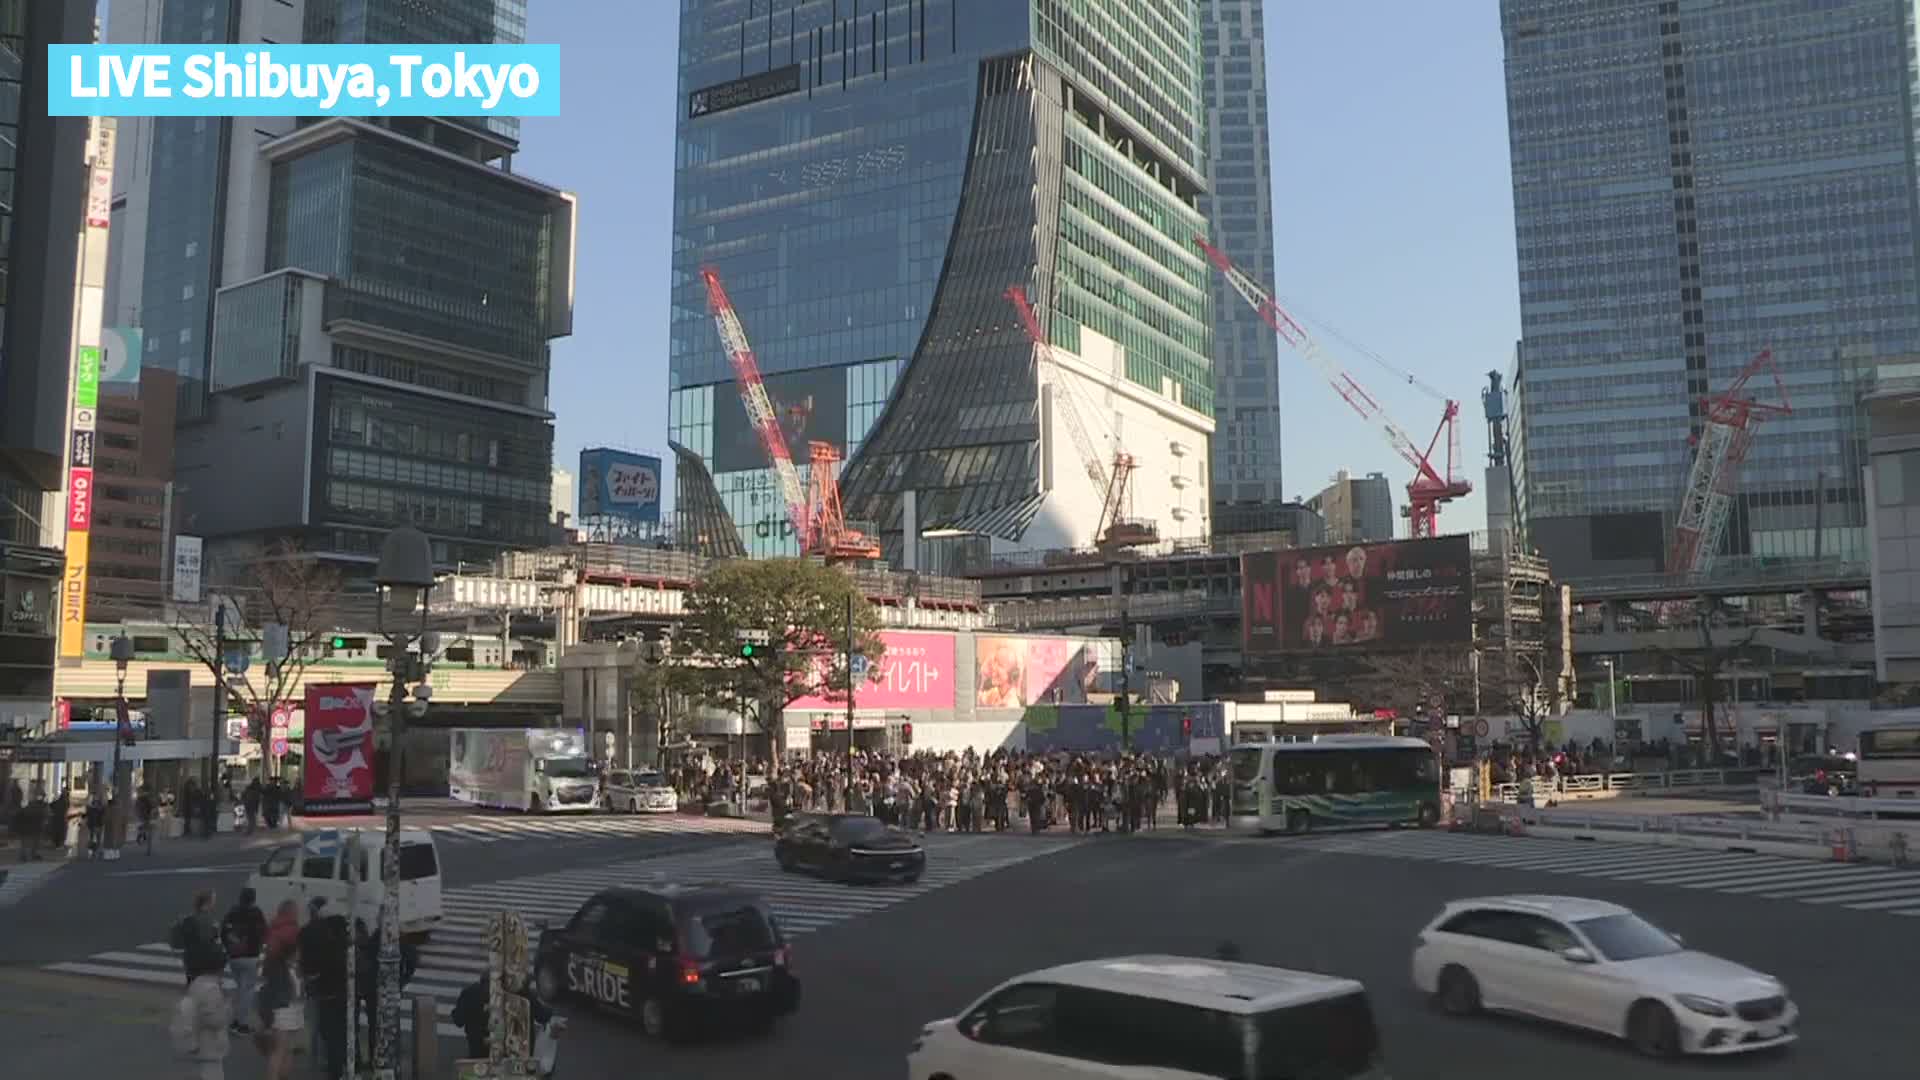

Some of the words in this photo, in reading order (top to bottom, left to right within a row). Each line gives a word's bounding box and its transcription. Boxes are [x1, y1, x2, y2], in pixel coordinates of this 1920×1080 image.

[756, 513, 793, 541] dip
[66, 564, 85, 623] プロミス
[568, 961, 632, 1009] S.RIDE
